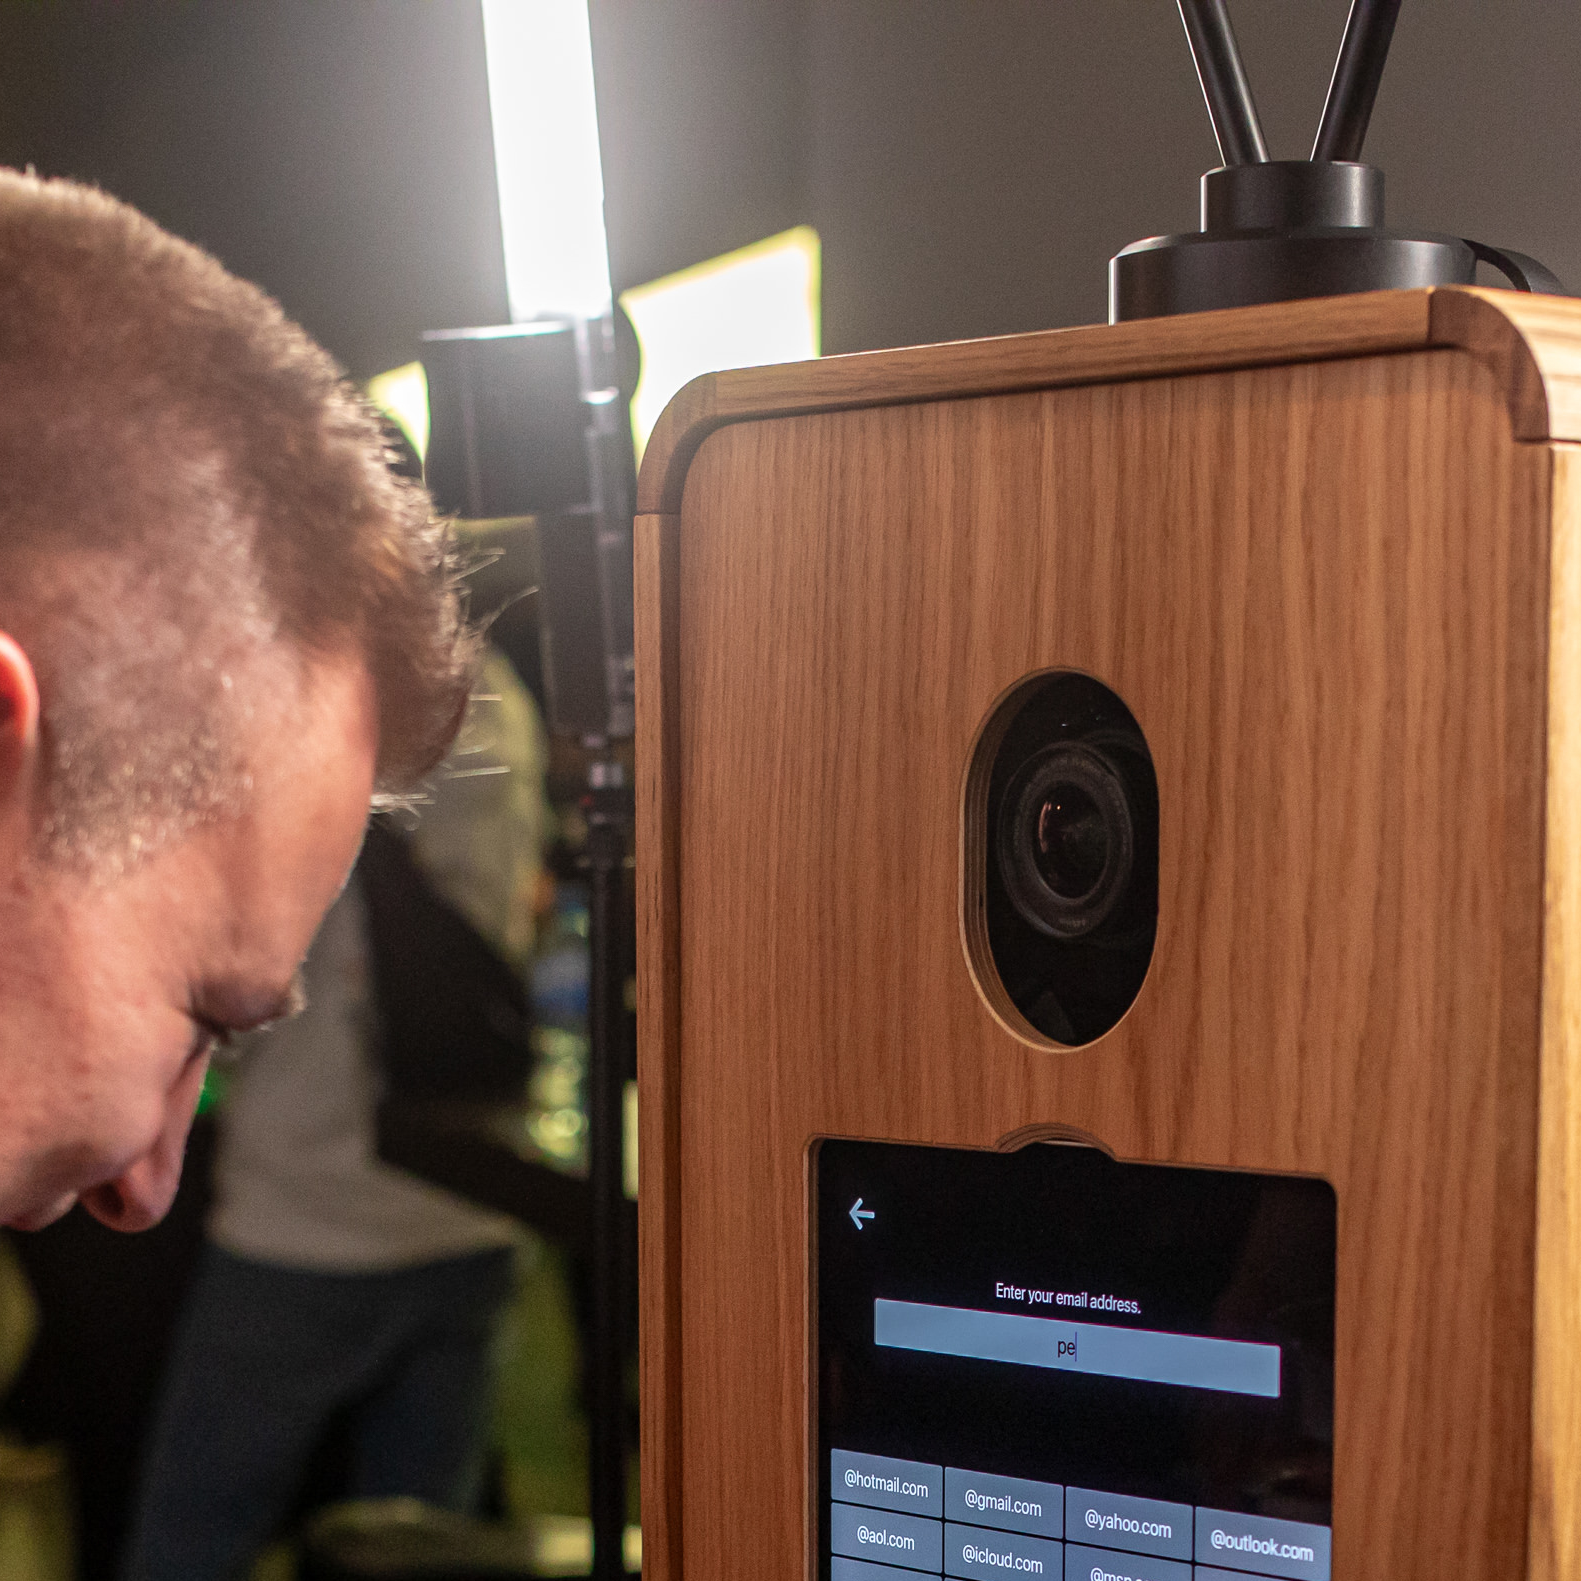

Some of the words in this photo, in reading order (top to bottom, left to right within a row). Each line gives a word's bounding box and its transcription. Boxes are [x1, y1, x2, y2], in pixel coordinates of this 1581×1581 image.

[995, 1282, 1027, 1301] Enter
[1027, 1289, 1055, 1305] your
[1055, 1291, 1088, 1308] email
[1089, 1293, 1142, 1314] address.
[1057, 1340, 1075, 1358] pe
[844, 1469, 929, 1498] @hotmail.com
[964, 1489, 1042, 1517] @gmail.com
[856, 1525, 915, 1551] @aol.com
[1084, 1508, 1172, 1539] @yahoo.com
[962, 1544, 1043, 1574] @icloud.com
[1210, 1529, 1314, 1562] @outlook.com
